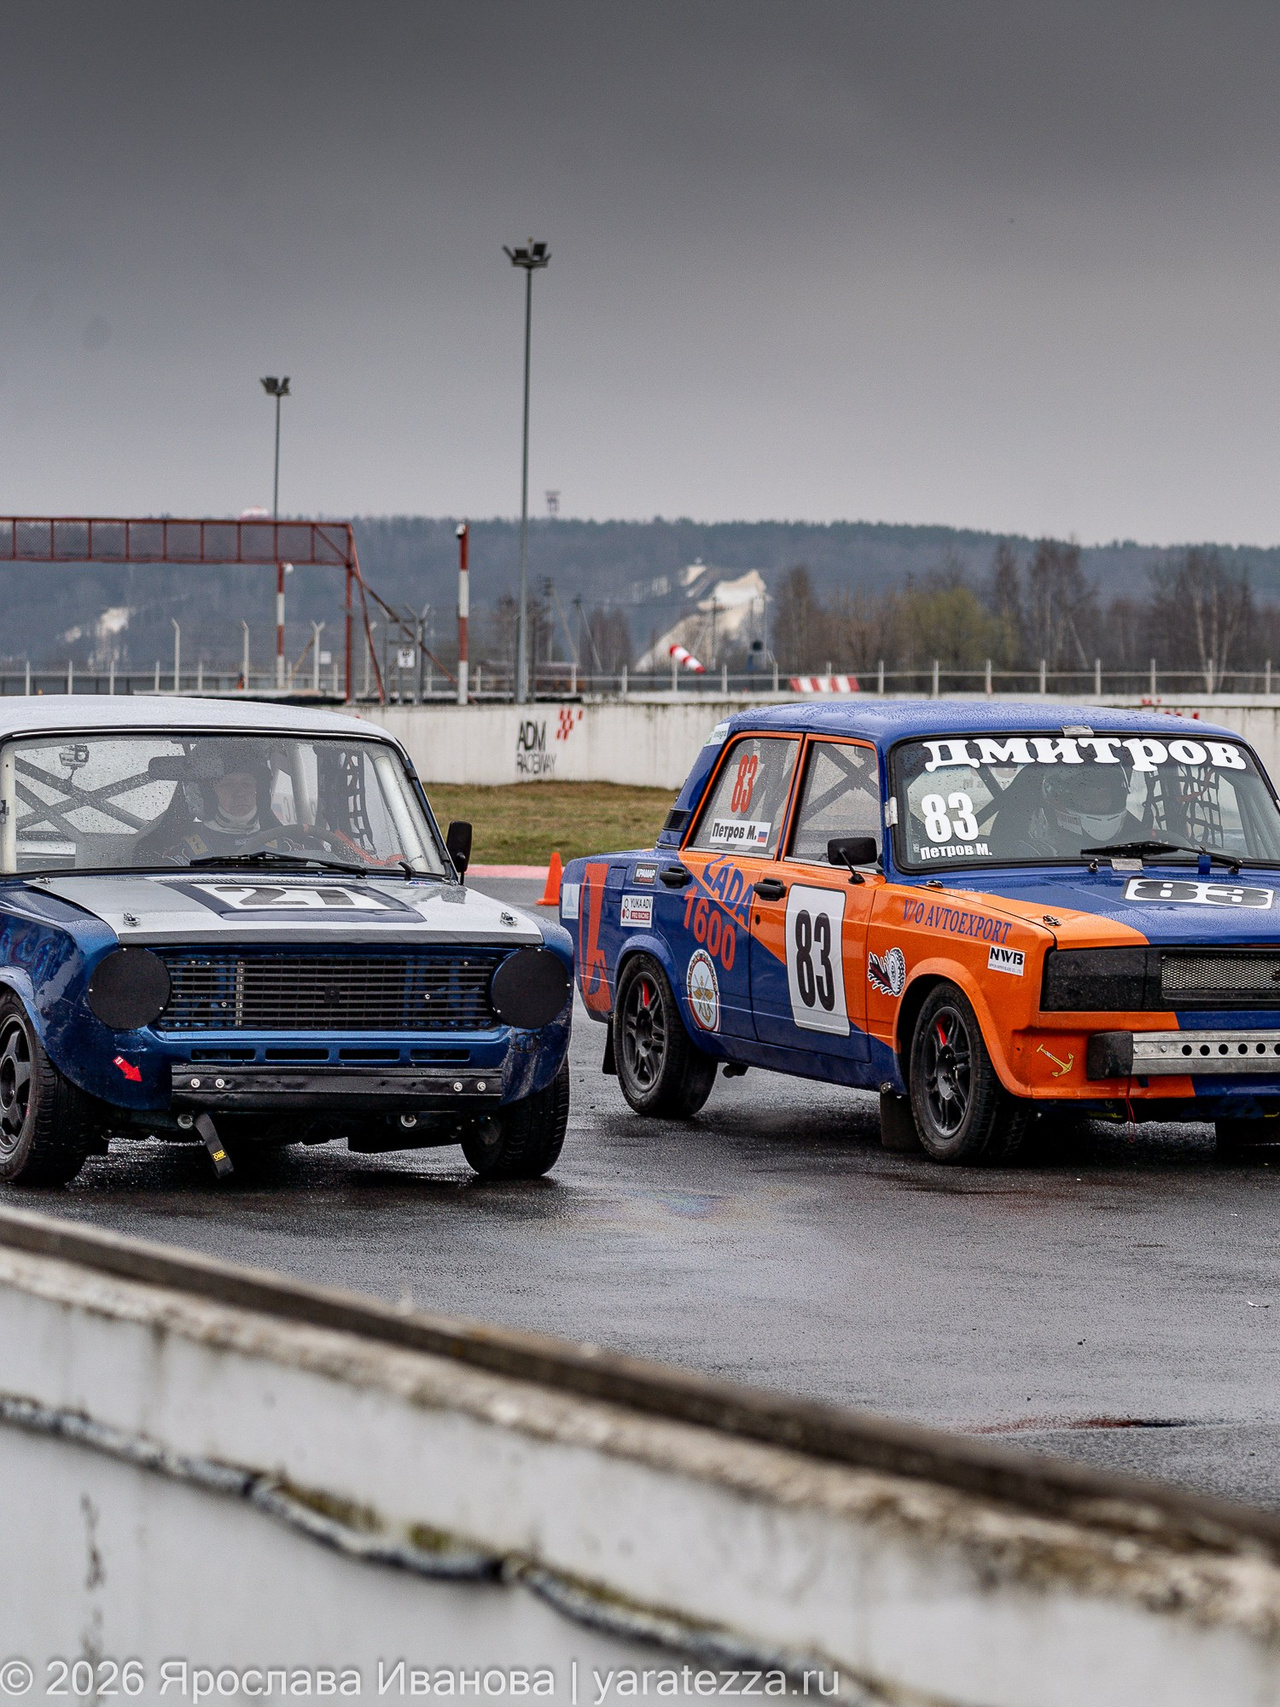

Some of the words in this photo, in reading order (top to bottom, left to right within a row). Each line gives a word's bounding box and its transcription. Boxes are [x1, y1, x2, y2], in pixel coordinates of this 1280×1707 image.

[517, 720, 547, 753] ADM
[516, 753, 557, 774] RACEWAY
[731, 754, 758, 814] 83
[711, 822, 744, 841] Петров
[746, 825, 757, 840] М.
[921, 792, 979, 843] 83
[975, 843, 992, 856] М.
[702, 855, 754, 928] LADA
[1133, 880, 1269, 907] 83
[683, 885, 736, 971] 1600
[903, 899, 925, 924] V/O
[924, 905, 1013, 945] AVTOEXPORT
[795, 909, 835, 1012] 83
[990, 947, 1024, 966] NWB
